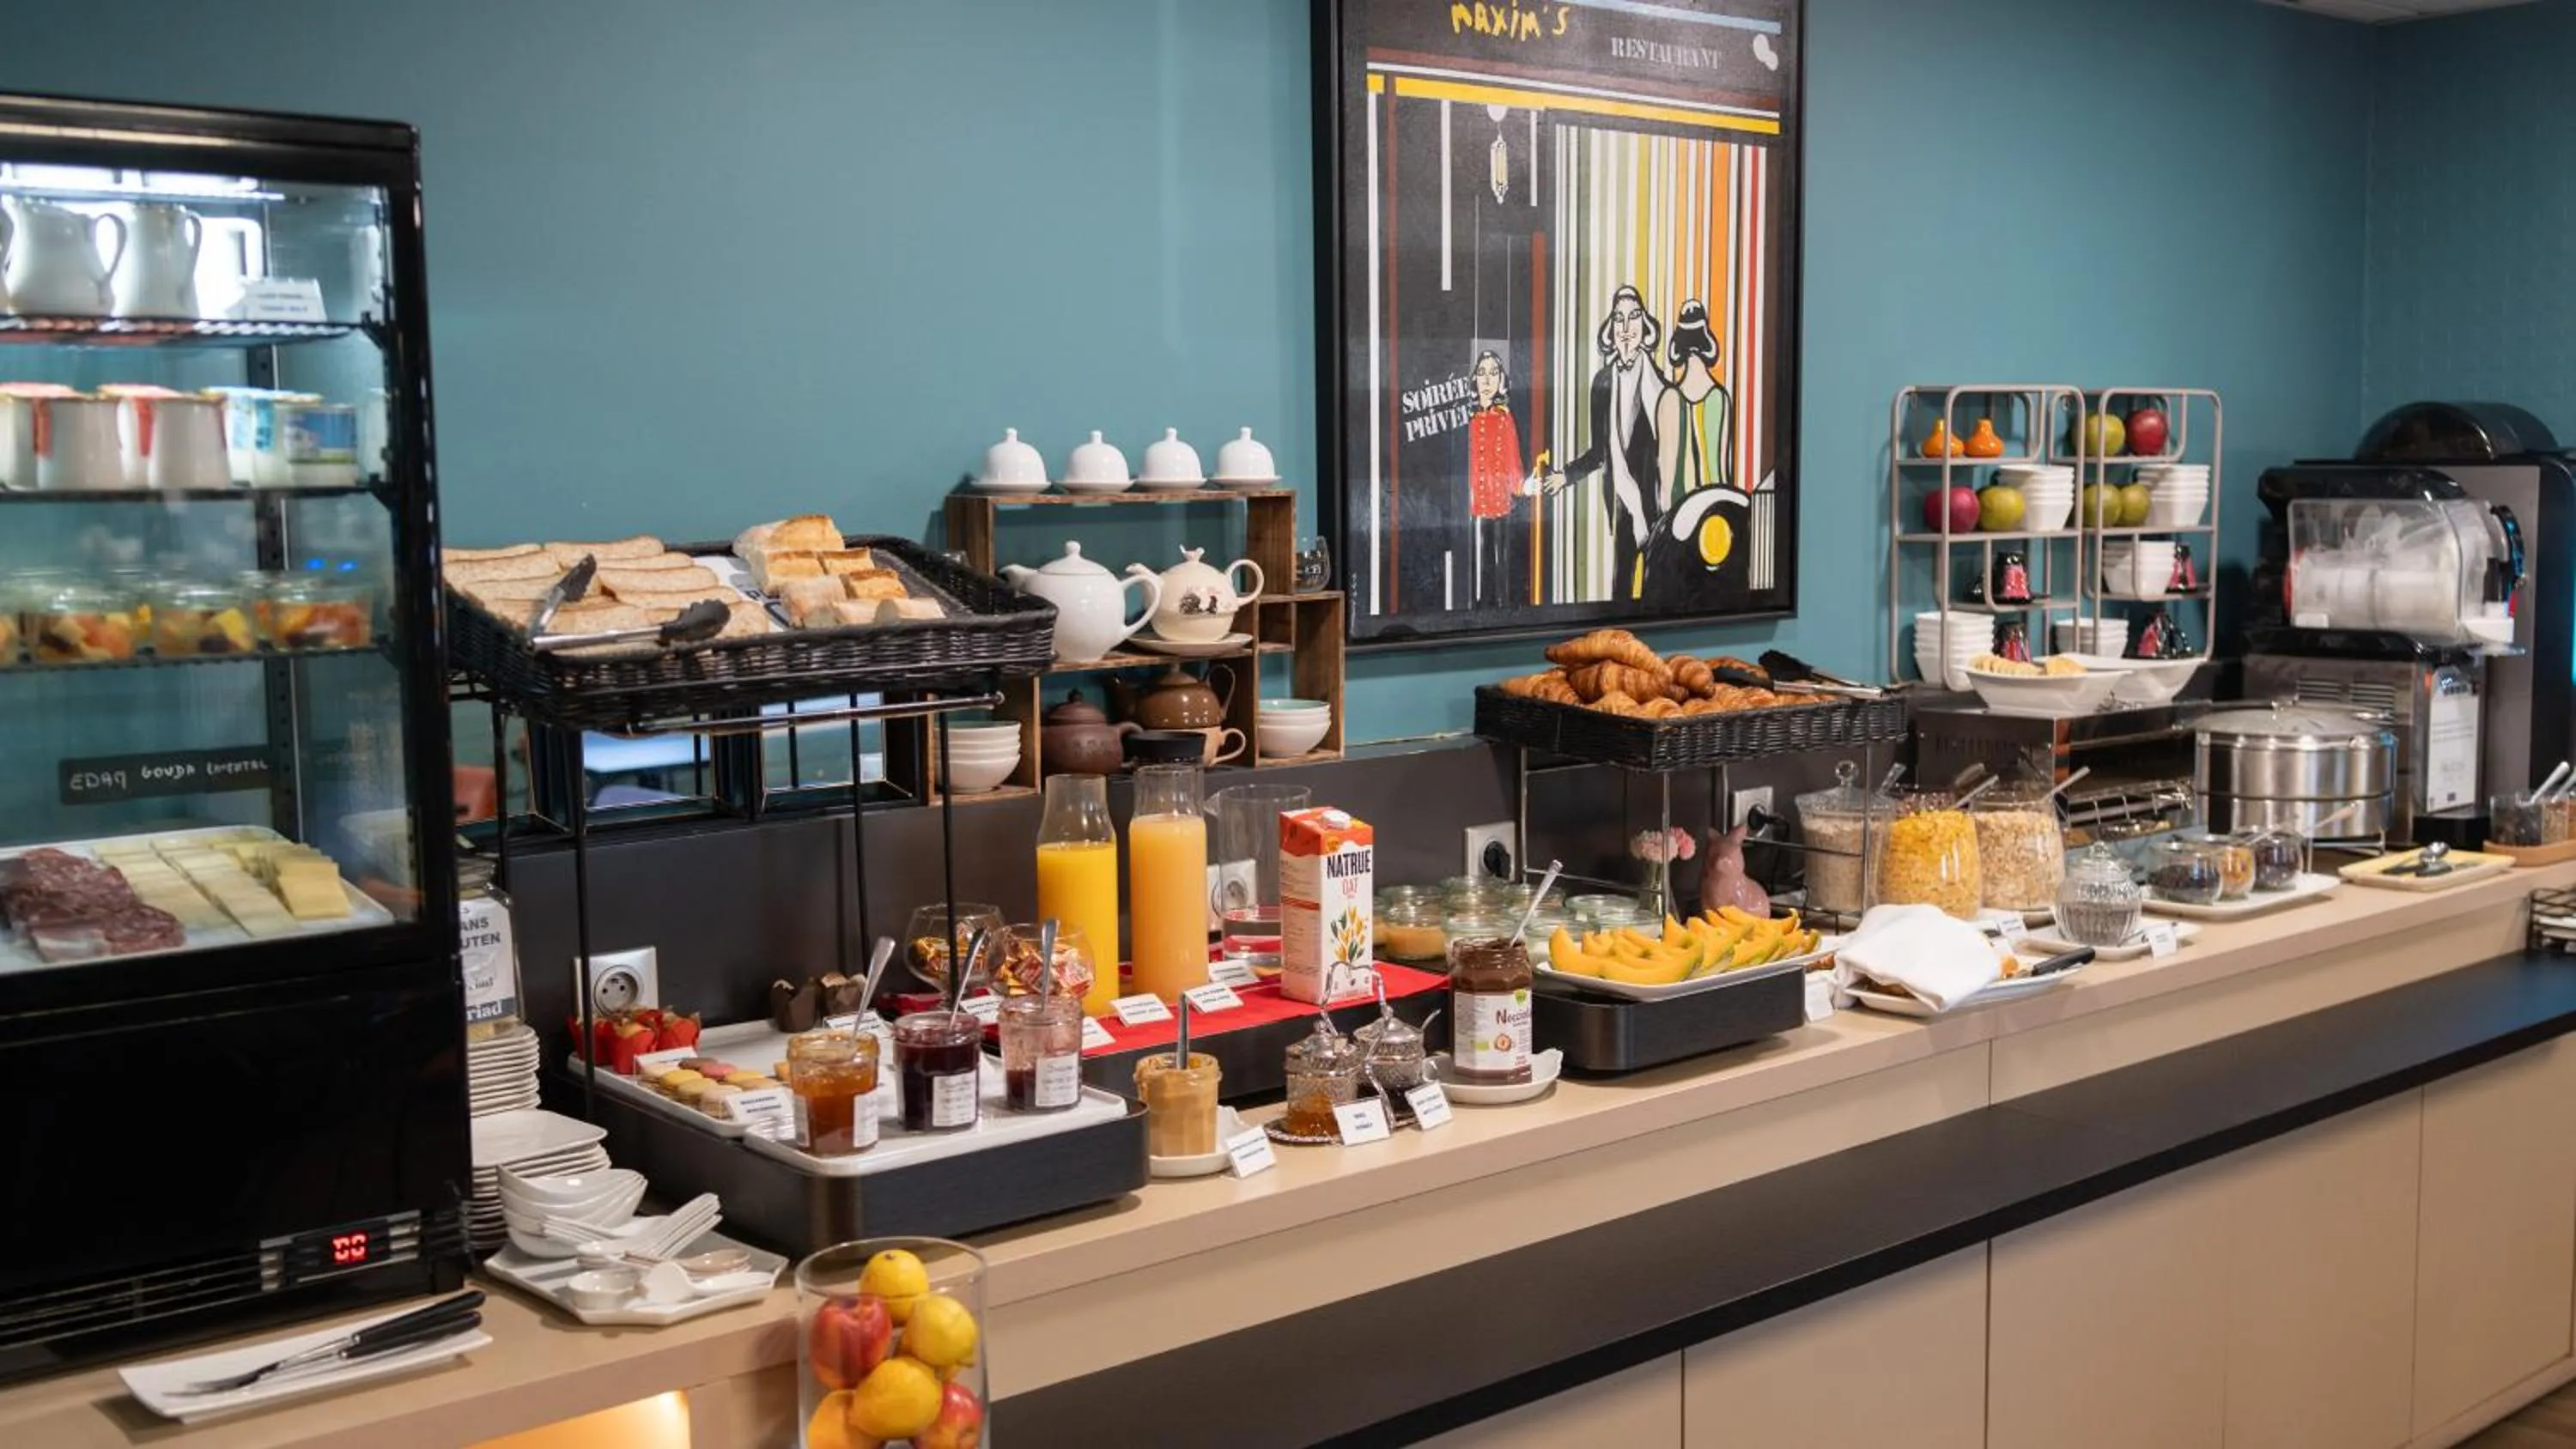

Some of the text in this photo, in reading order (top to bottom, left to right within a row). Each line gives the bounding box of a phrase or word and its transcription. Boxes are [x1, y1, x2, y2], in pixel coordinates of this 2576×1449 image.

[141, 763, 196, 779] GOUDA
[1327, 849, 1371, 880] NATRUE
[461, 917, 489, 931] ANS
[461, 932, 501, 949] UTEN
